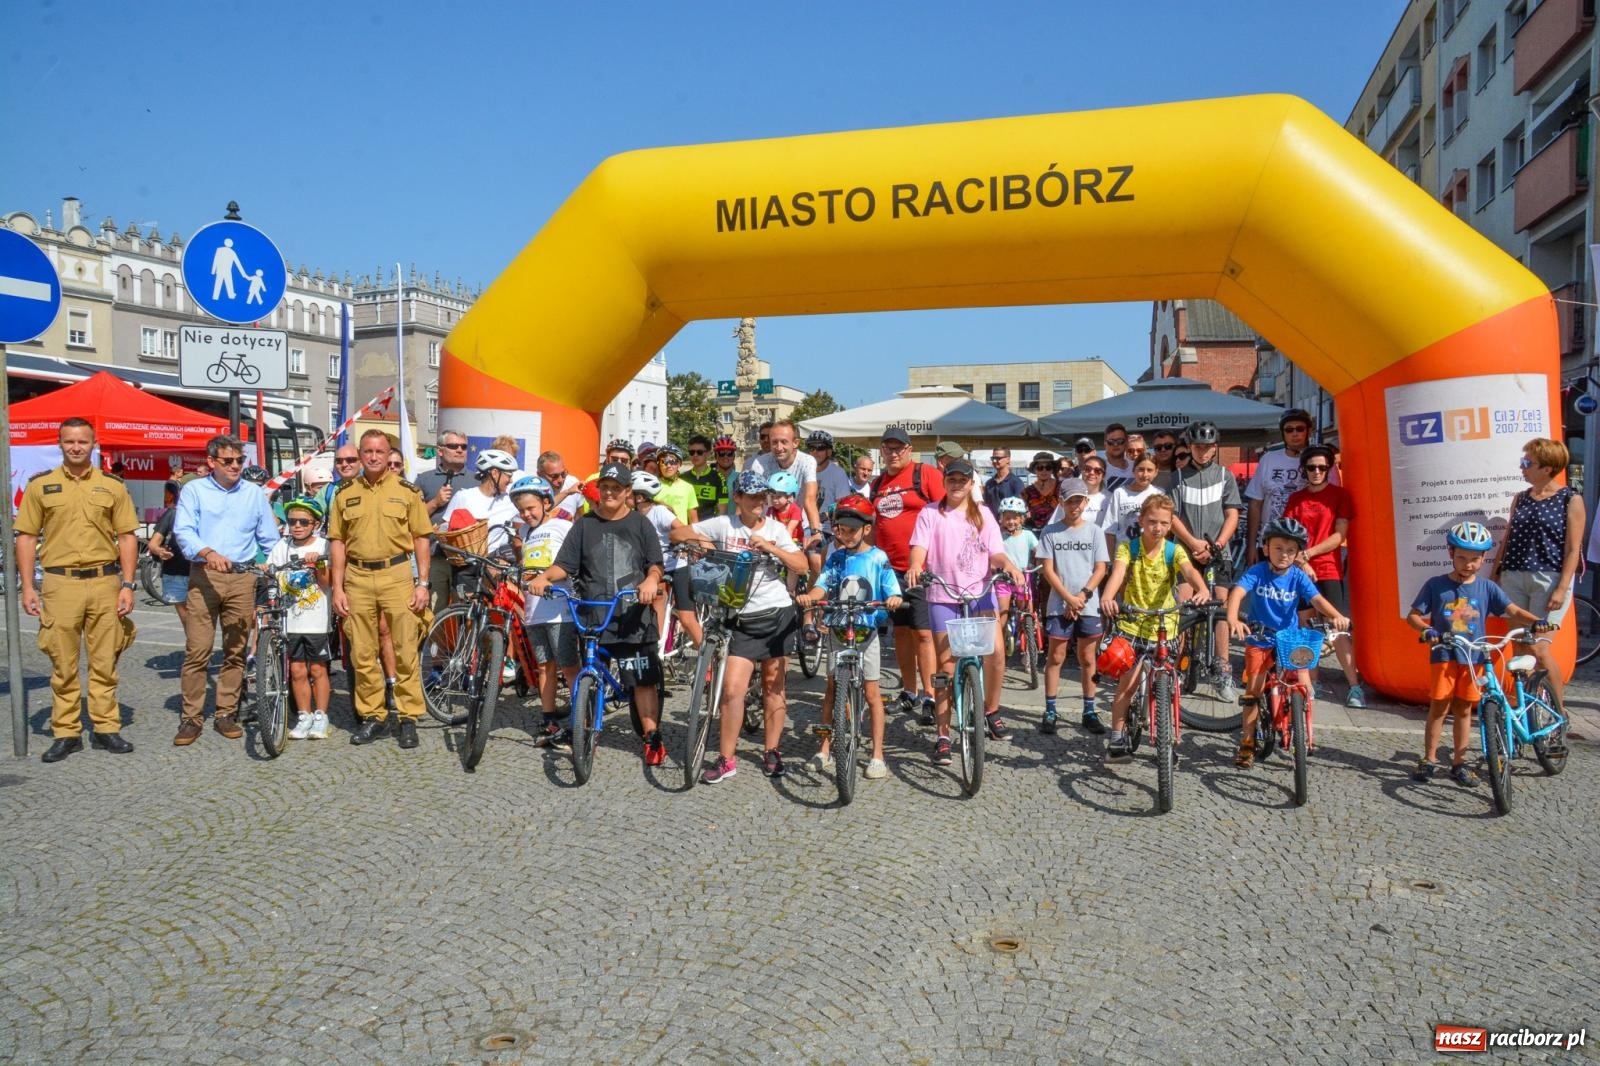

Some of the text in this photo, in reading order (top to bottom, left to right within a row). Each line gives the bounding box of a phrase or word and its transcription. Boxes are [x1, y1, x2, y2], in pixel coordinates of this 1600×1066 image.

[716, 163, 1135, 233] MIASTO RACIBÓRZ
[184, 330, 282, 351] Nie dotyczy
[1136, 413, 1190, 428] gelatopiu
[122, 453, 154, 471] krwi
[1421, 480, 1448, 488] Projekt
[1456, 477, 1488, 485] numerze
[1489, 475, 1523, 484] rejestracy
[1054, 541, 1092, 551] adidas
[1256, 584, 1298, 602] adidas
